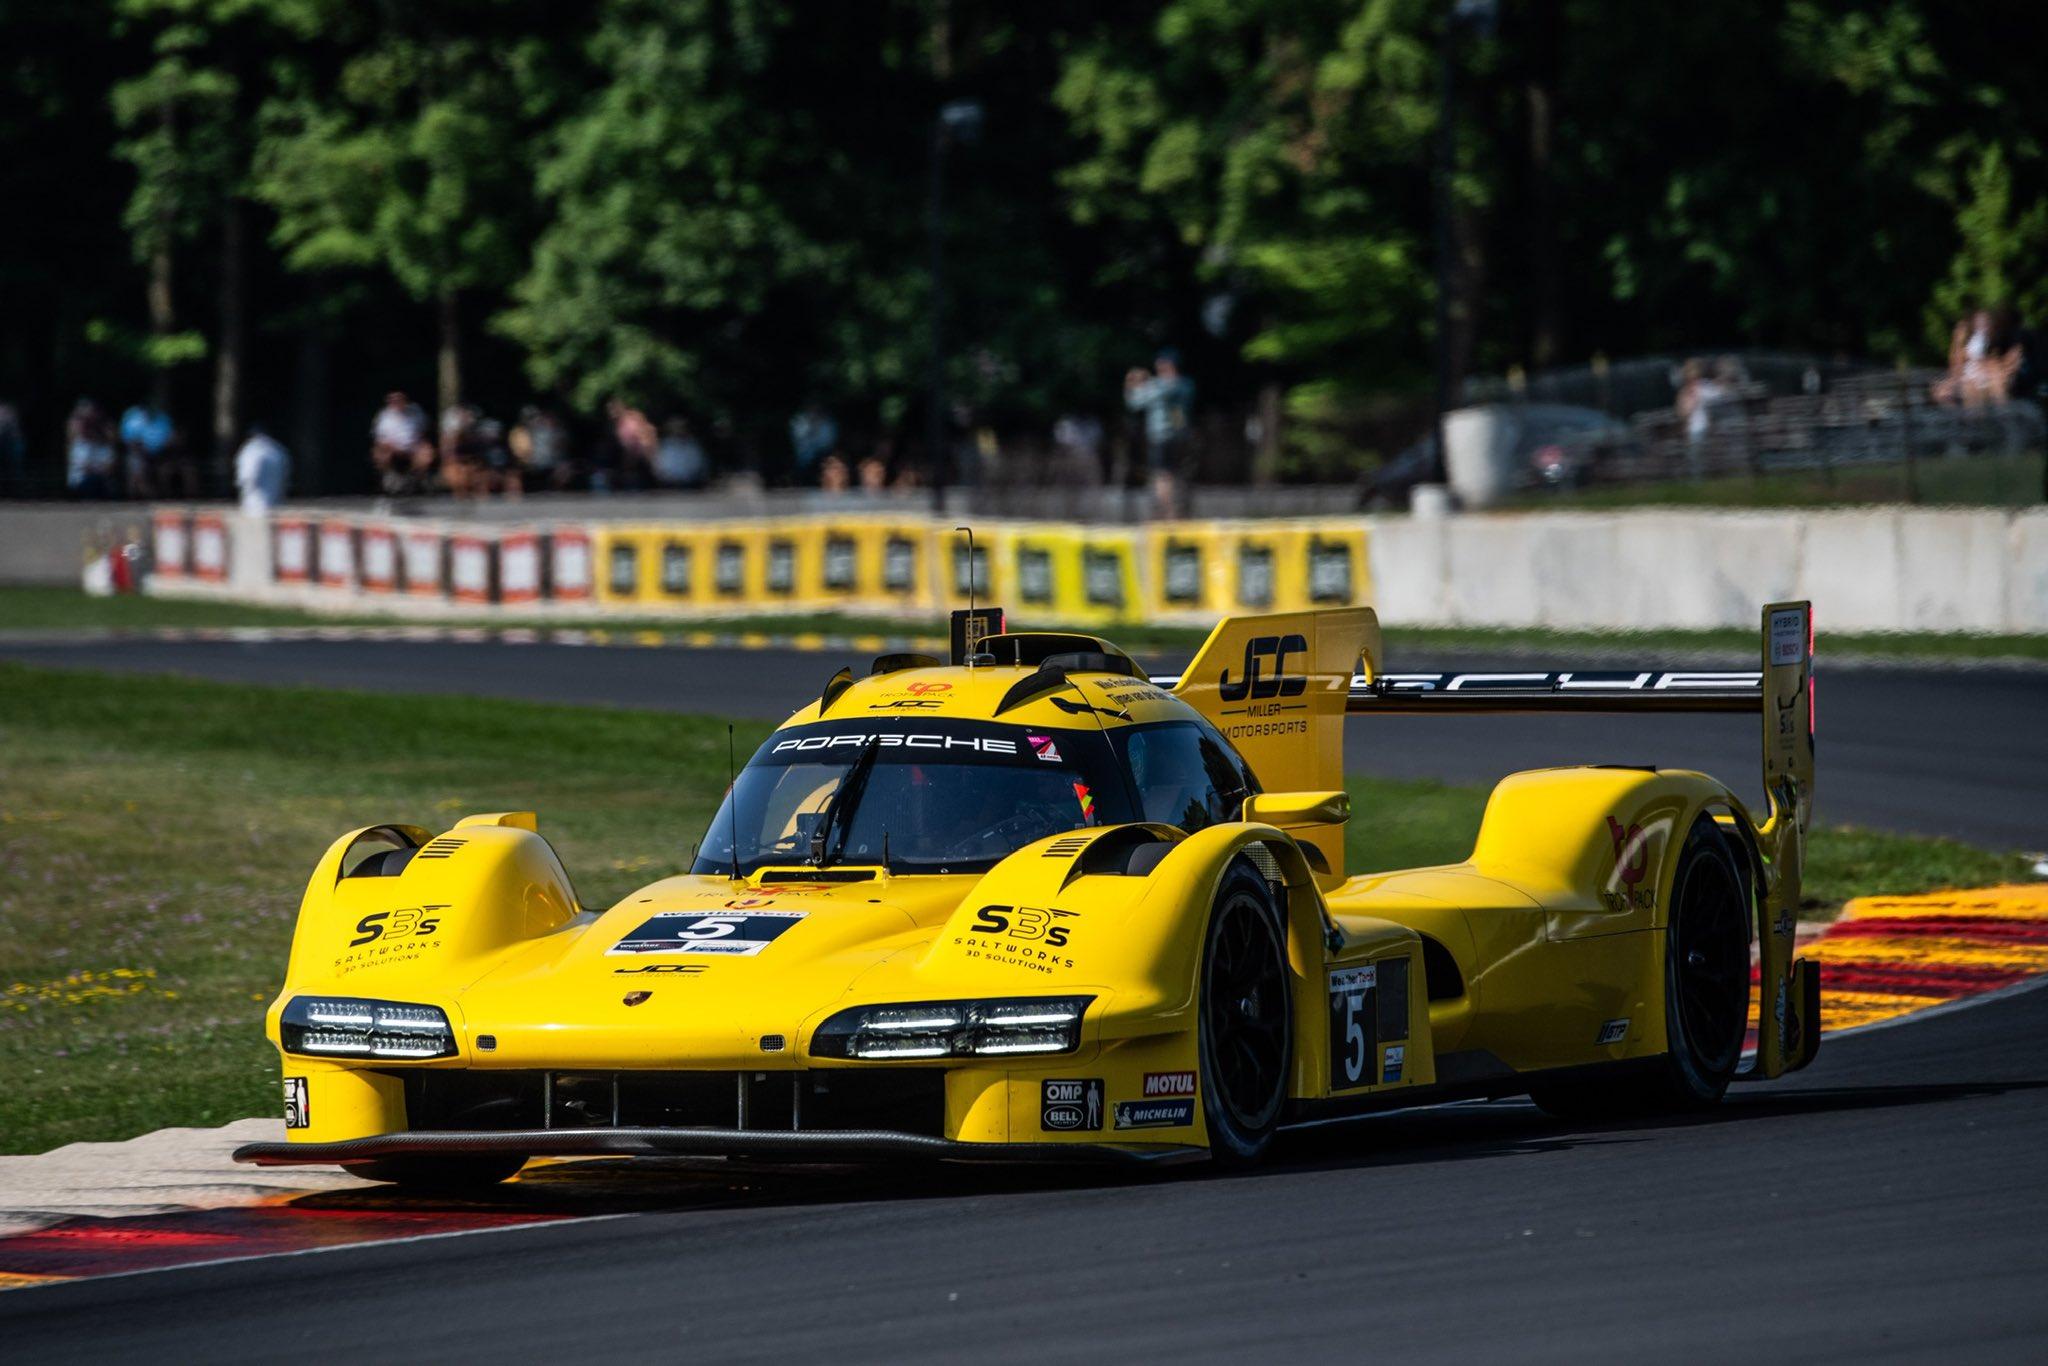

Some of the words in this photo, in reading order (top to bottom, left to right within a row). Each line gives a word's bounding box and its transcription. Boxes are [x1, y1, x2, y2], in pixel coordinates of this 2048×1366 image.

[1219, 634, 1308, 702] JDC
[1247, 703, 1281, 718] MILLER
[1222, 720, 1307, 740] MOTORSPORTS
[772, 734, 1017, 754] PORSCHE
[678, 916, 749, 939] 5
[334, 940, 441, 967] SALTWORKS
[360, 953, 420, 969] SOLUTIONS
[954, 937, 1074, 969] SALTWORKS
[966, 949, 980, 958] 3D
[985, 953, 1053, 974] SOLUTIONS
[1345, 994, 1364, 1082] 5
[1046, 1085, 1083, 1100] OMP
[1146, 1074, 1194, 1094] MOTUL
[1050, 1111, 1078, 1121] BELL
[1133, 1107, 1187, 1121] MICHELIN
